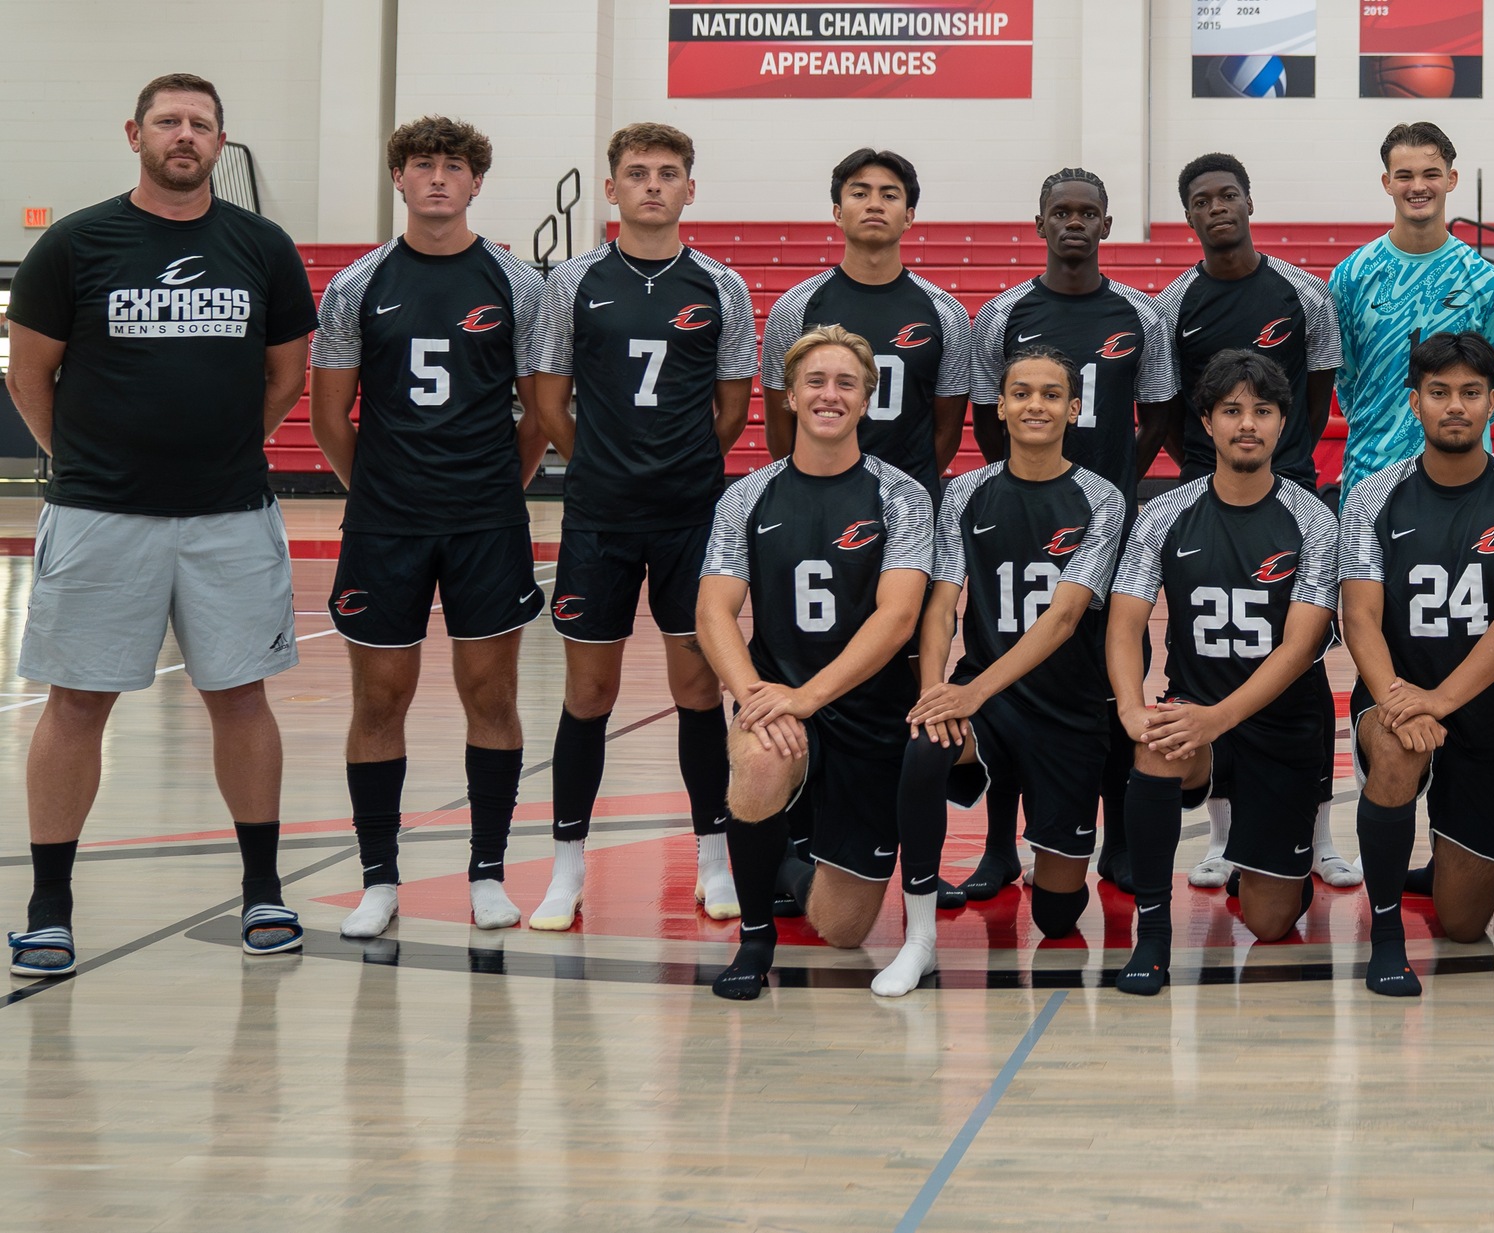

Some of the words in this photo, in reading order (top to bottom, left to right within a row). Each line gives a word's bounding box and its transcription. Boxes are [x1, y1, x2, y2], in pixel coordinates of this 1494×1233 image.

[691, 12, 813, 37] NATIONAL
[818, 12, 1009, 37] CHAMPIONSHIP
[1197, 7, 1221, 16] 2012
[1197, 21, 1221, 30] 2015
[1237, 7, 1260, 16] 2024
[1363, 6, 1389, 16] 2013
[759, 51, 937, 76] APPEARANCES
[25, 207, 47, 226] EXIT
[108, 287, 251, 322] EXPRESS
[114, 325, 167, 335] MEN'S
[177, 324, 243, 334] SOCCER
[410, 338, 450, 406] 5
[628, 338, 668, 407] 7
[867, 354, 905, 421] 0
[1076, 362, 1097, 428] 1
[794, 559, 836, 632] 6
[996, 561, 1062, 633] 12
[1408, 562, 1489, 638] 24
[1190, 586, 1273, 659] 25
